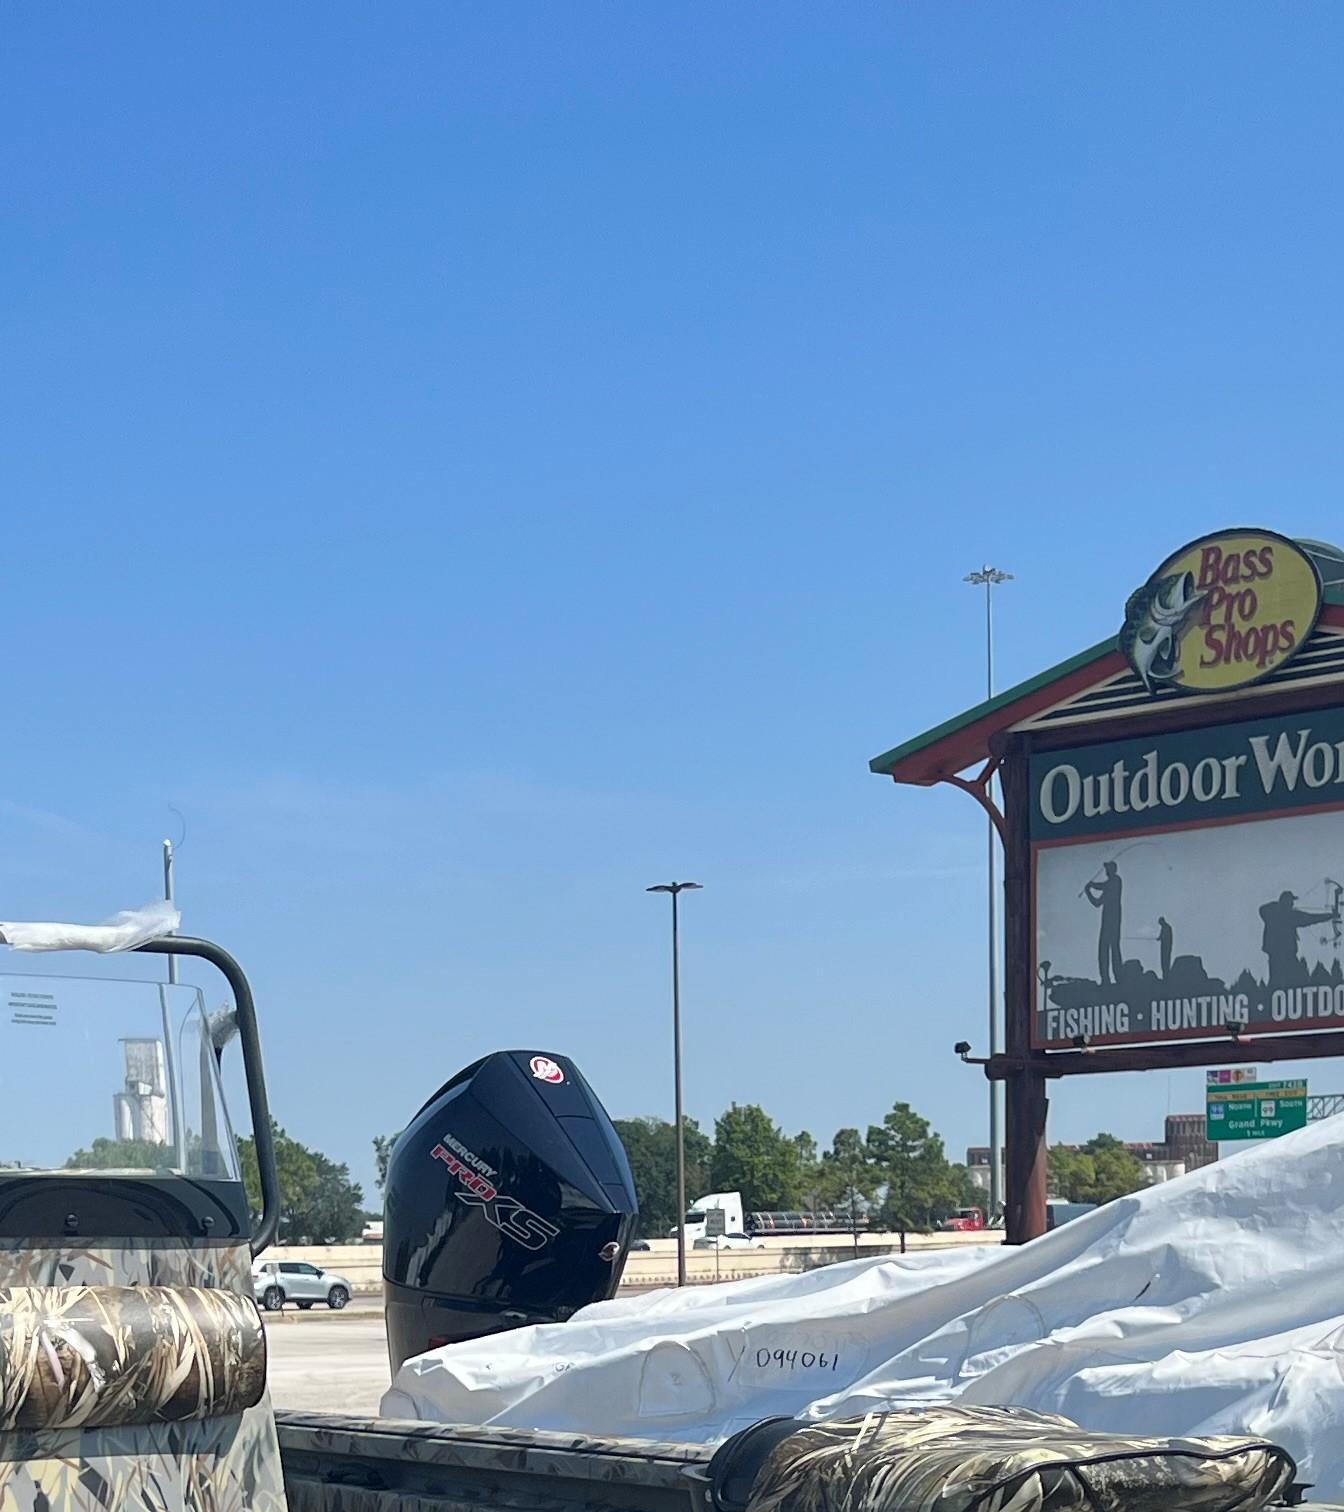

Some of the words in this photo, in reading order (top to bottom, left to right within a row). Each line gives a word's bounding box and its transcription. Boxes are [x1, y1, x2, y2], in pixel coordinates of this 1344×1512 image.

[1197, 546, 1274, 591] Bass
[1200, 586, 1258, 628] Pro
[1199, 620, 1296, 669] Shops
[1039, 750, 1248, 824] Outdoor
[1047, 1003, 1130, 1041] FISHING
[1151, 994, 1249, 1032] HUNTING
[1228, 1119, 1256, 1129] Grand
[1260, 1118, 1284, 1129] Pkwy
[430, 1143, 498, 1202] PRO
[443, 1133, 498, 1178] MERCURY
[454, 1191, 561, 1251] XS
[756, 1347, 839, 1372] 094061
